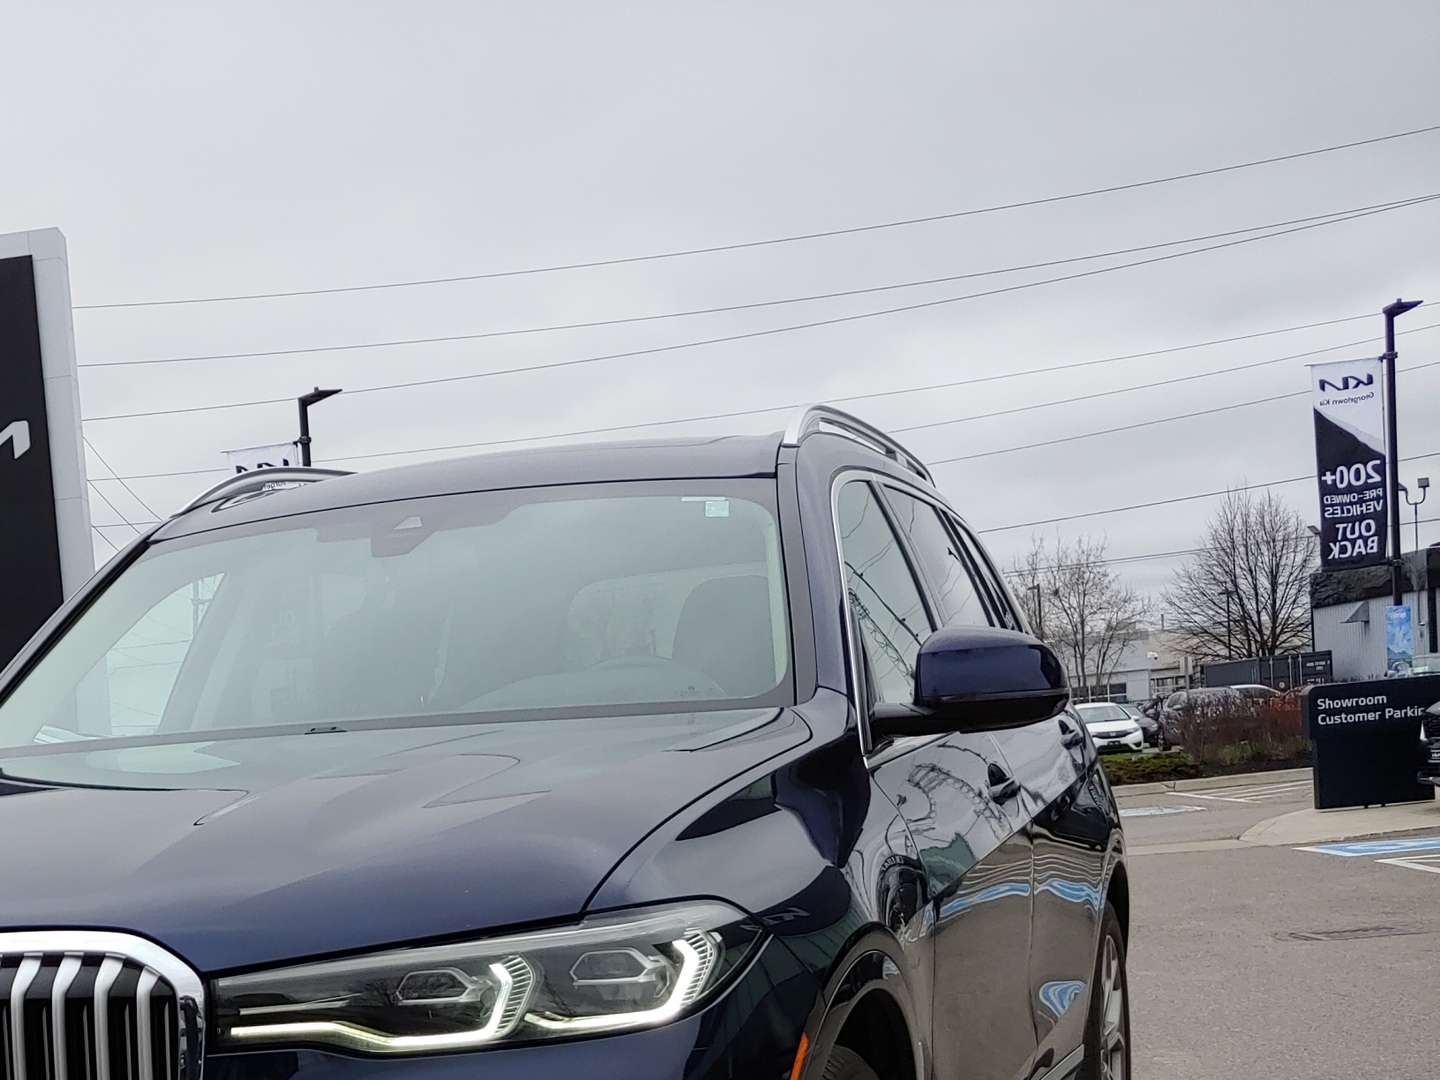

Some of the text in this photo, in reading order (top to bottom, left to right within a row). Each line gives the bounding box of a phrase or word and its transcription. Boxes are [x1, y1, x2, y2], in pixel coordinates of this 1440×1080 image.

[1317, 695, 1387, 710] Showroom
[1318, 705, 1425, 725] Customer Parki
